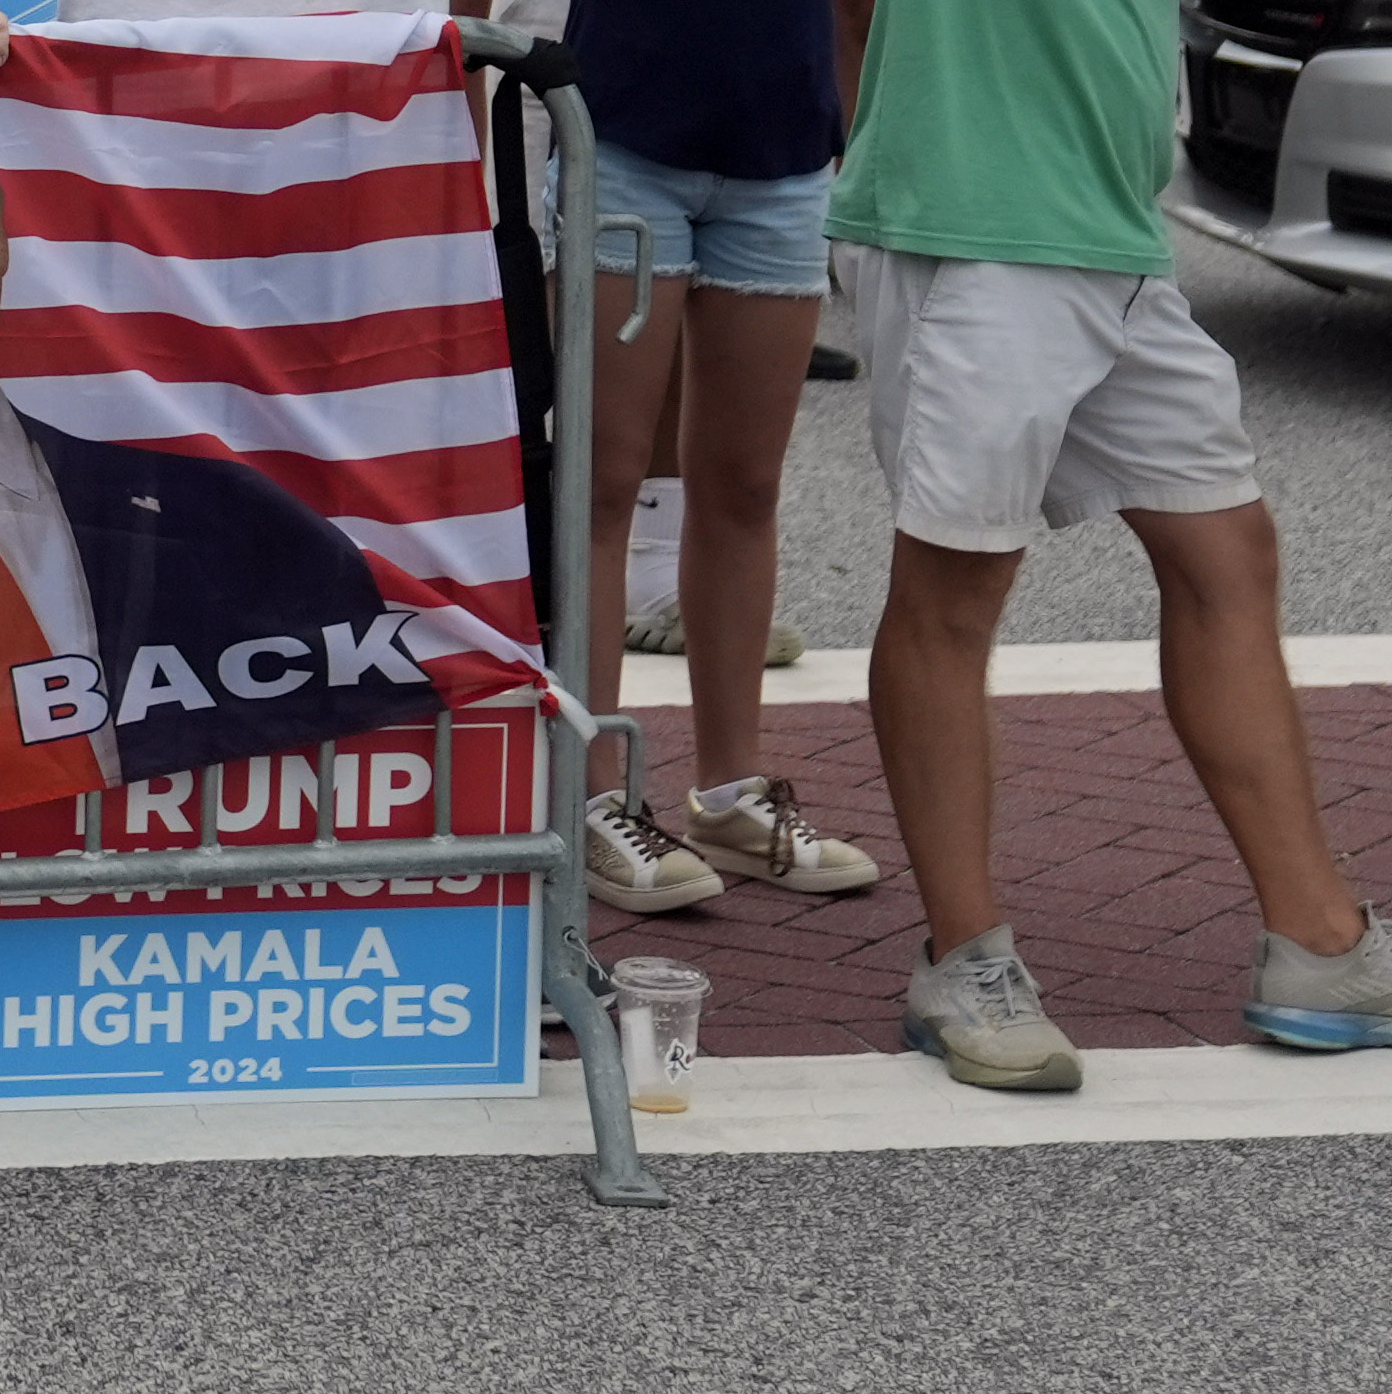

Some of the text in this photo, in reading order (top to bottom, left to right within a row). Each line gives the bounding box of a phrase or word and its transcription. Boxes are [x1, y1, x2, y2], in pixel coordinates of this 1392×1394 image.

[11, 610, 433, 745] BACK
[74, 752, 433, 835] RUMP
[79, 926, 400, 987] KAMALA
[2, 983, 472, 1049] HIGH PRICES
[187, 1056, 283, 1085] 2024
